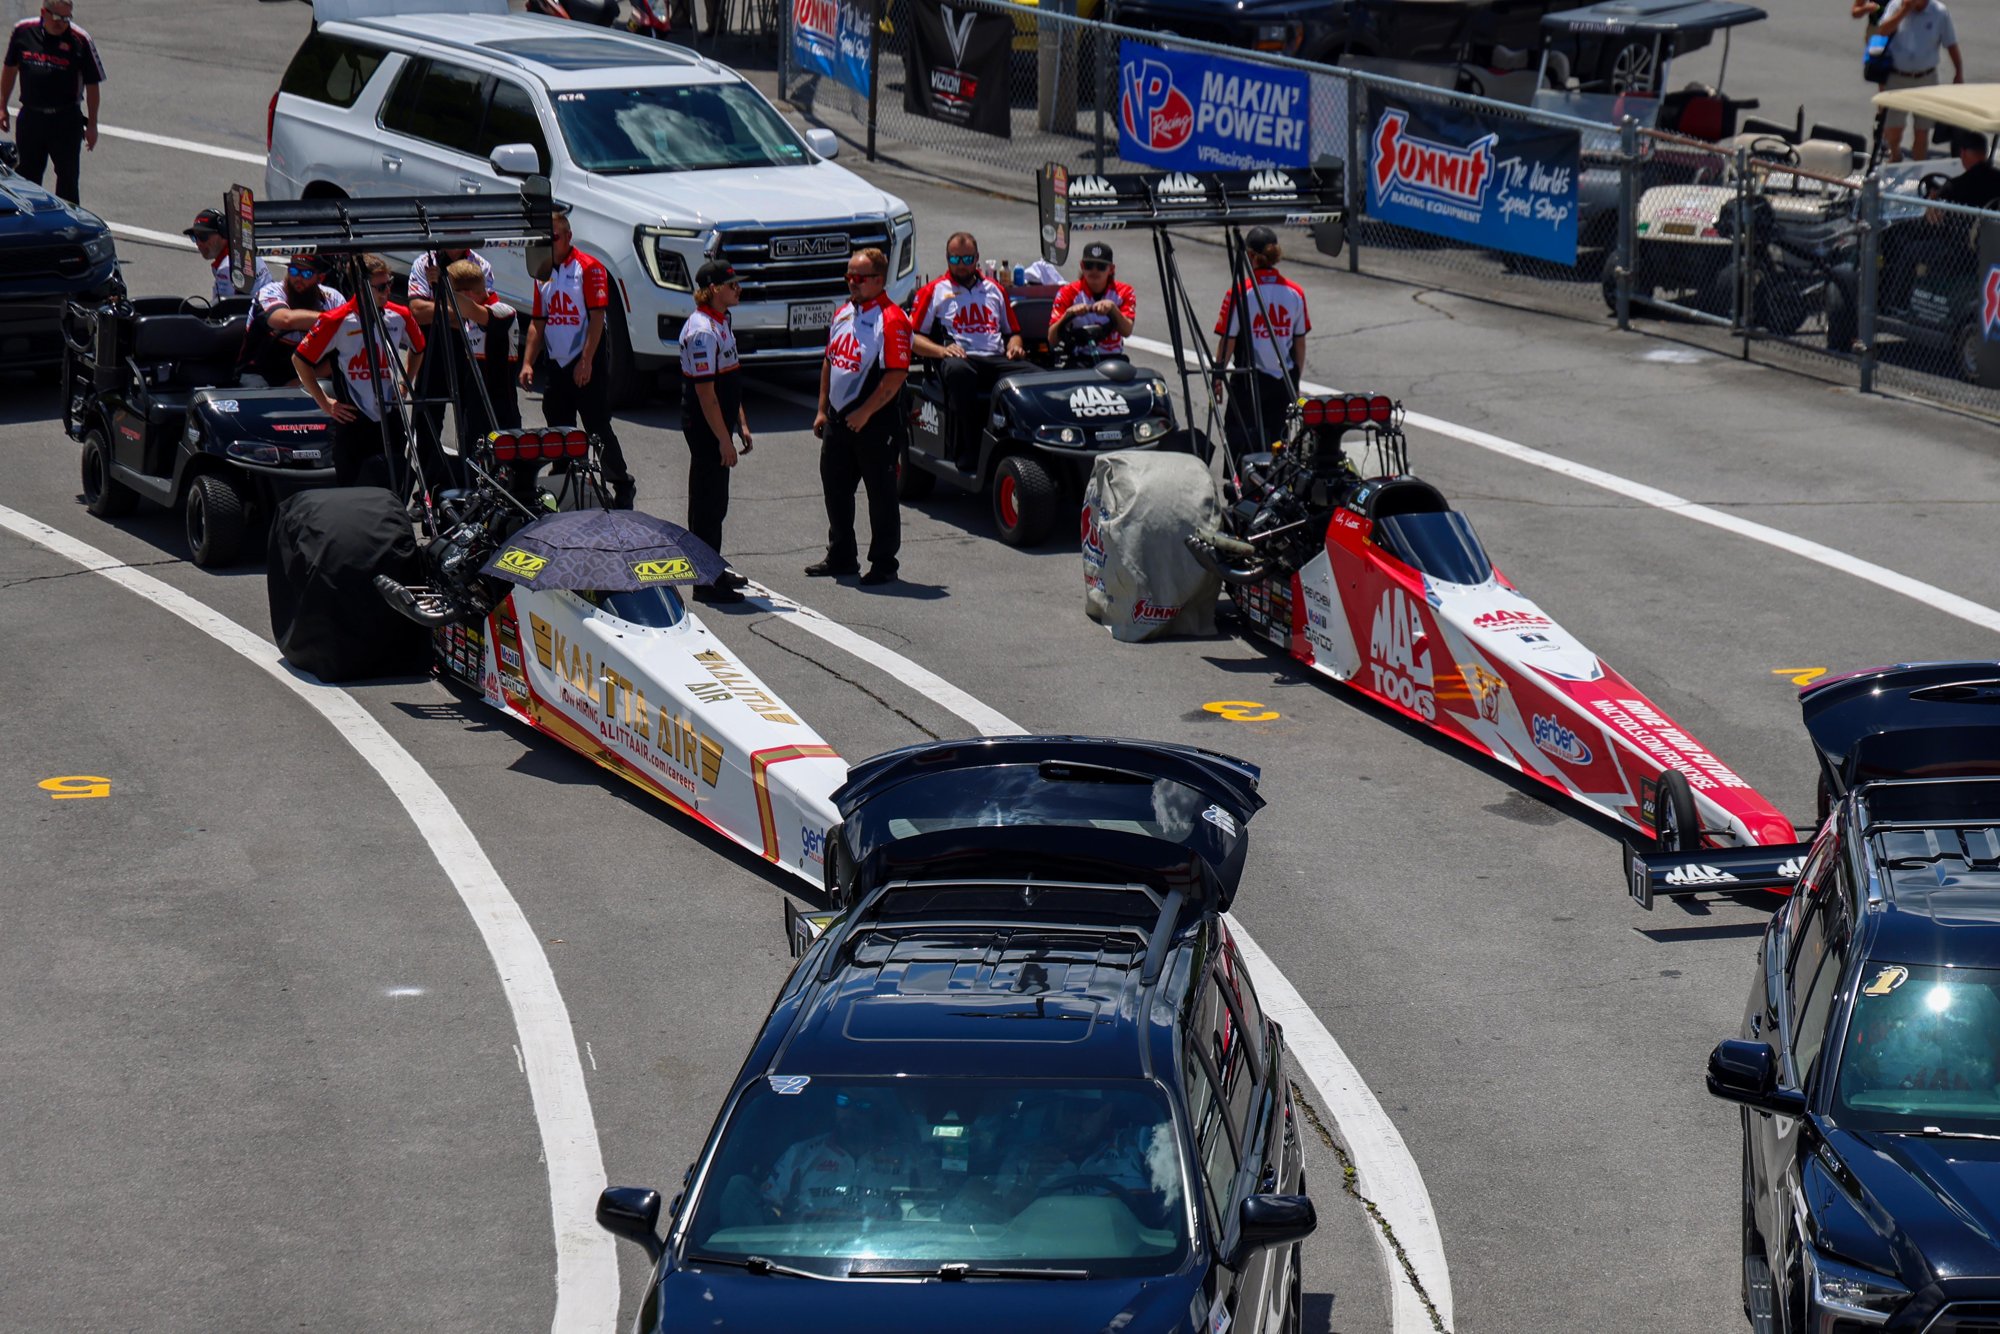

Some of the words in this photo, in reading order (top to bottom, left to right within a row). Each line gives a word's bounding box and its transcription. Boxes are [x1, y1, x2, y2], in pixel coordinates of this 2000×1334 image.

[931, 70, 961, 94] VIZION
[1201, 70, 1300, 116] MAKIN'
[1152, 112, 1193, 140] Racing
[1196, 102, 1306, 151] POWER!
[1068, 174, 1118, 197] MAC
[1157, 171, 1206, 195] MAC
[1248, 168, 1297, 193] MAC
[1497, 156, 1528, 192] The
[1529, 160, 1571, 195] World's
[1391, 191, 1425, 210] RACING
[1426, 200, 1482, 223] EQUIPMENT
[1497, 188, 1531, 224] Speed
[1072, 224, 1110, 232] Mobil
[1287, 216, 1325, 224] Mobil
[259, 247, 299, 256] Mobil
[485, 240, 525, 248] Mobil
[777, 235, 850, 257] GMC
[546, 316, 580, 326] OOLS
[953, 303, 997, 329] MAC
[1252, 303, 1292, 330] MAC
[828, 332, 863, 363] MAC
[1069, 386, 1127, 408] MAC
[919, 401, 939, 426] MAC
[1071, 405, 1130, 418] TOOLS
[639, 573, 674, 583] MECHANIX
[674, 571, 695, 580] WEAR
[1133, 599, 1183, 620] SUMMI
[1308, 608, 1322, 625] Mobil
[1473, 609, 1548, 625] MAC
[1370, 587, 1435, 689] MAC
[684, 682, 734, 704] AIR
[700, 661, 783, 713] KALITTA
[554, 628, 650, 742] KALITTA
[656, 704, 699, 777] AIR
[559, 685, 576, 707] NOW
[575, 697, 599, 725] HIRING
[1202, 700, 1281, 722] 3
[1533, 714, 1575, 752] gerber
[1590, 699, 1720, 790] MACTOOLS.COM/FRANCHISE
[1615, 699, 1671, 728] DRIVE
[1653, 727, 1704, 752] YOUR
[1684, 752, 1753, 790] FUTURE
[1664, 863, 1738, 882] MAC
[1864, 968, 1904, 995] 1
[779, 1075, 811, 1095] 2
